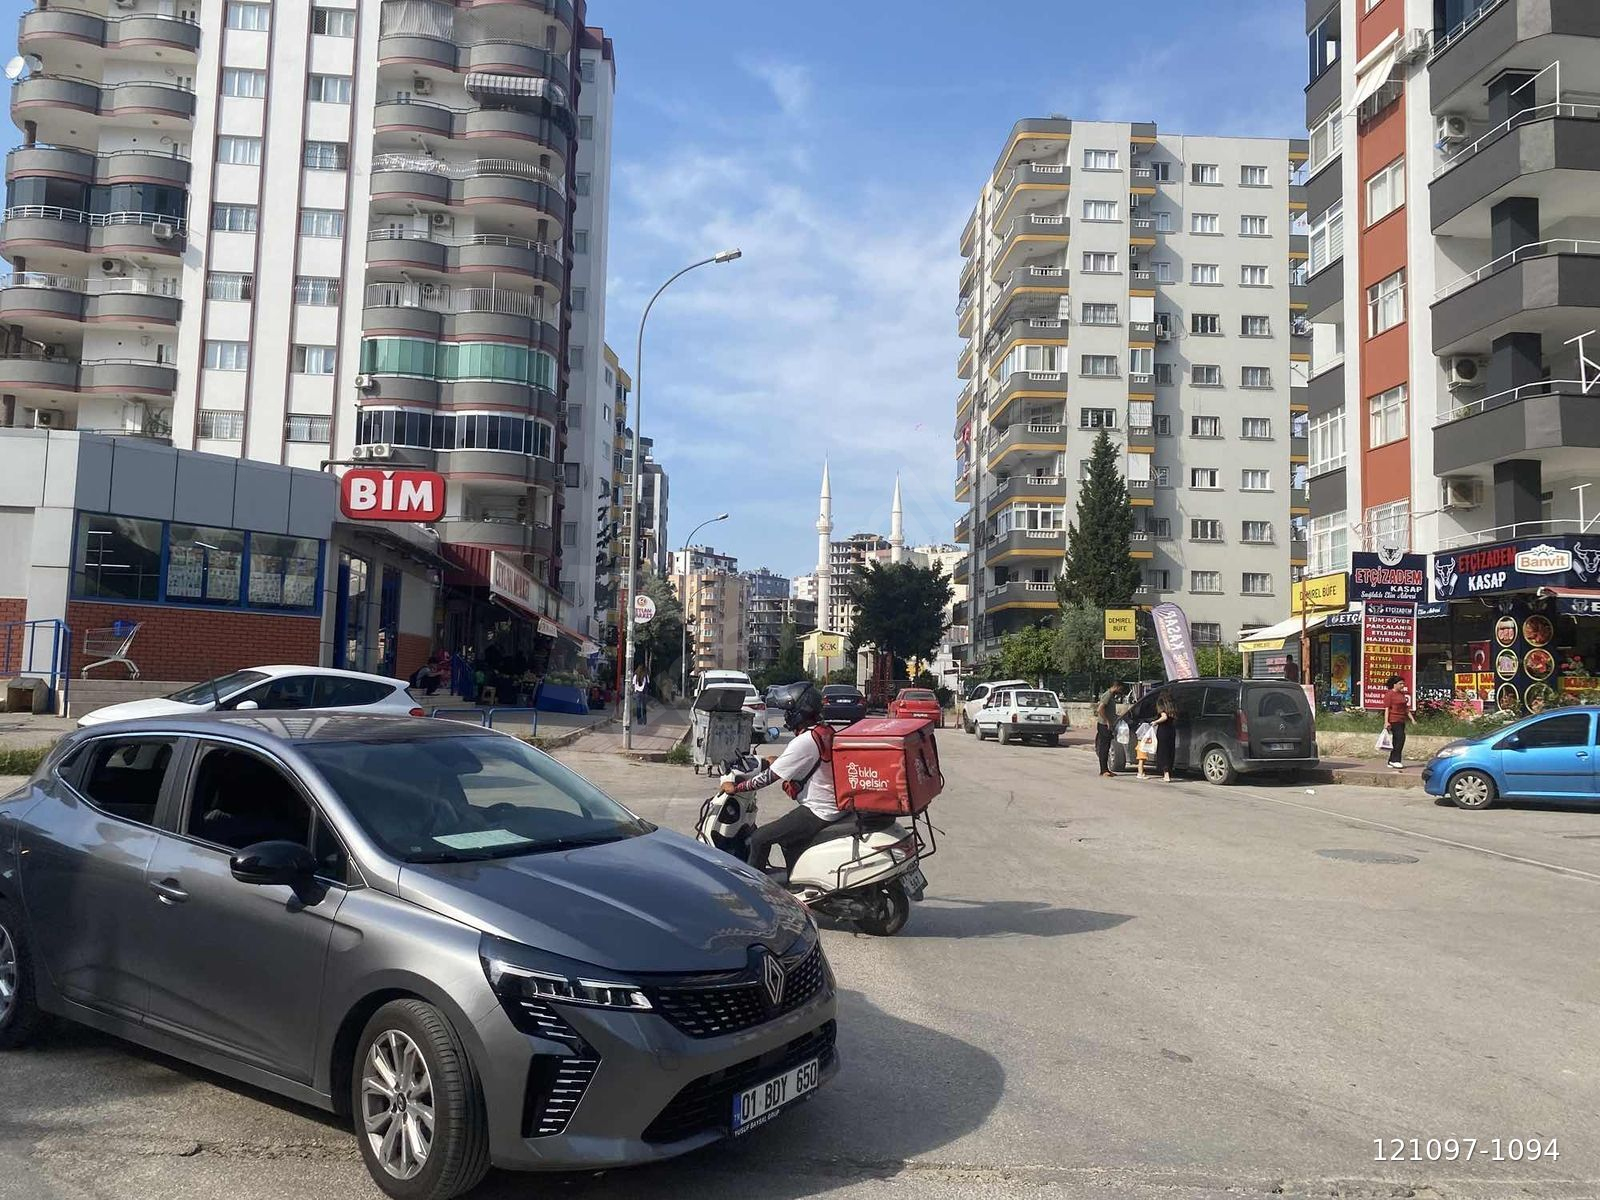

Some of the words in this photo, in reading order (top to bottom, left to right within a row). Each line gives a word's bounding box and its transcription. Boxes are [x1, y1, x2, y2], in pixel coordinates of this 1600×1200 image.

[350, 471, 433, 511] BİM
[1458, 546, 1517, 574] ETÇİZADEM
[1520, 555, 1566, 568] Banvit
[1355, 566, 1422, 587] ETÇİZADEM
[1468, 572, 1506, 591] KASAP
[859, 779, 887, 789] gelsin
[742, 1089, 756, 1120] 01
[765, 1075, 787, 1110] BDY
[796, 1062, 817, 1093] 650
